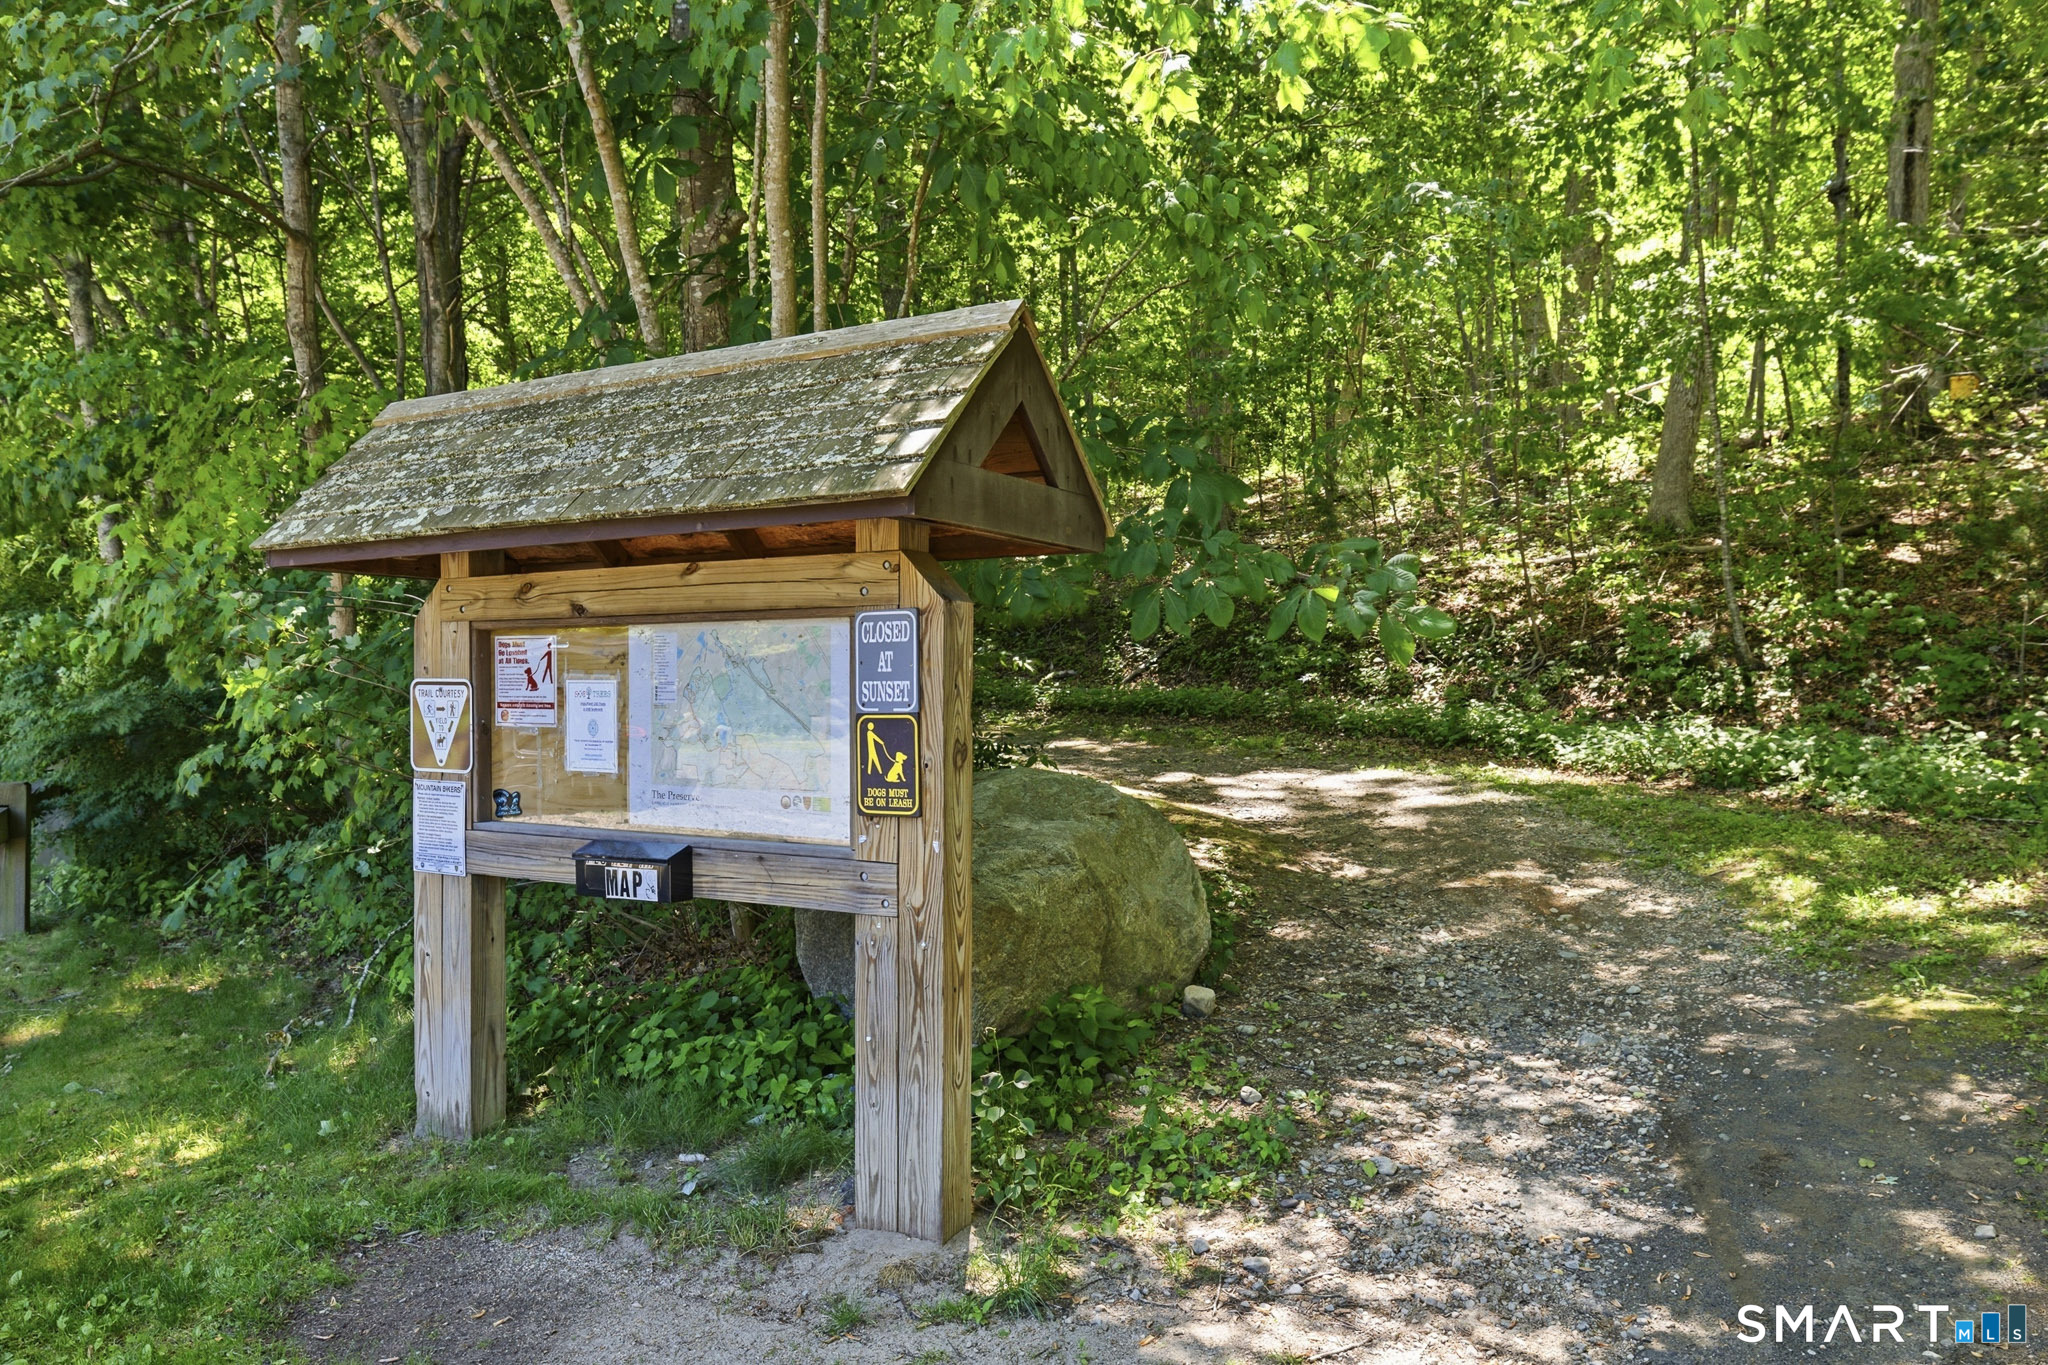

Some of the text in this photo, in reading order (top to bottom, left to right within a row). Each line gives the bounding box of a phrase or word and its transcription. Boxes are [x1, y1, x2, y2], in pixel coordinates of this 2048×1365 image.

[862, 620, 910, 643] CLOSED
[877, 651, 893, 672] AT
[418, 688, 465, 698] TRAIL COURTESY
[862, 680, 910, 702] SUNSET
[435, 717, 447, 725] YIELD
[438, 724, 445, 732] TO
[416, 783, 441, 792] MOUNTAIN
[867, 788, 909, 798] DOGS MUST
[651, 789, 666, 800] The
[864, 797, 913, 808] BE ON LEASH
[606, 869, 642, 898] MAP
